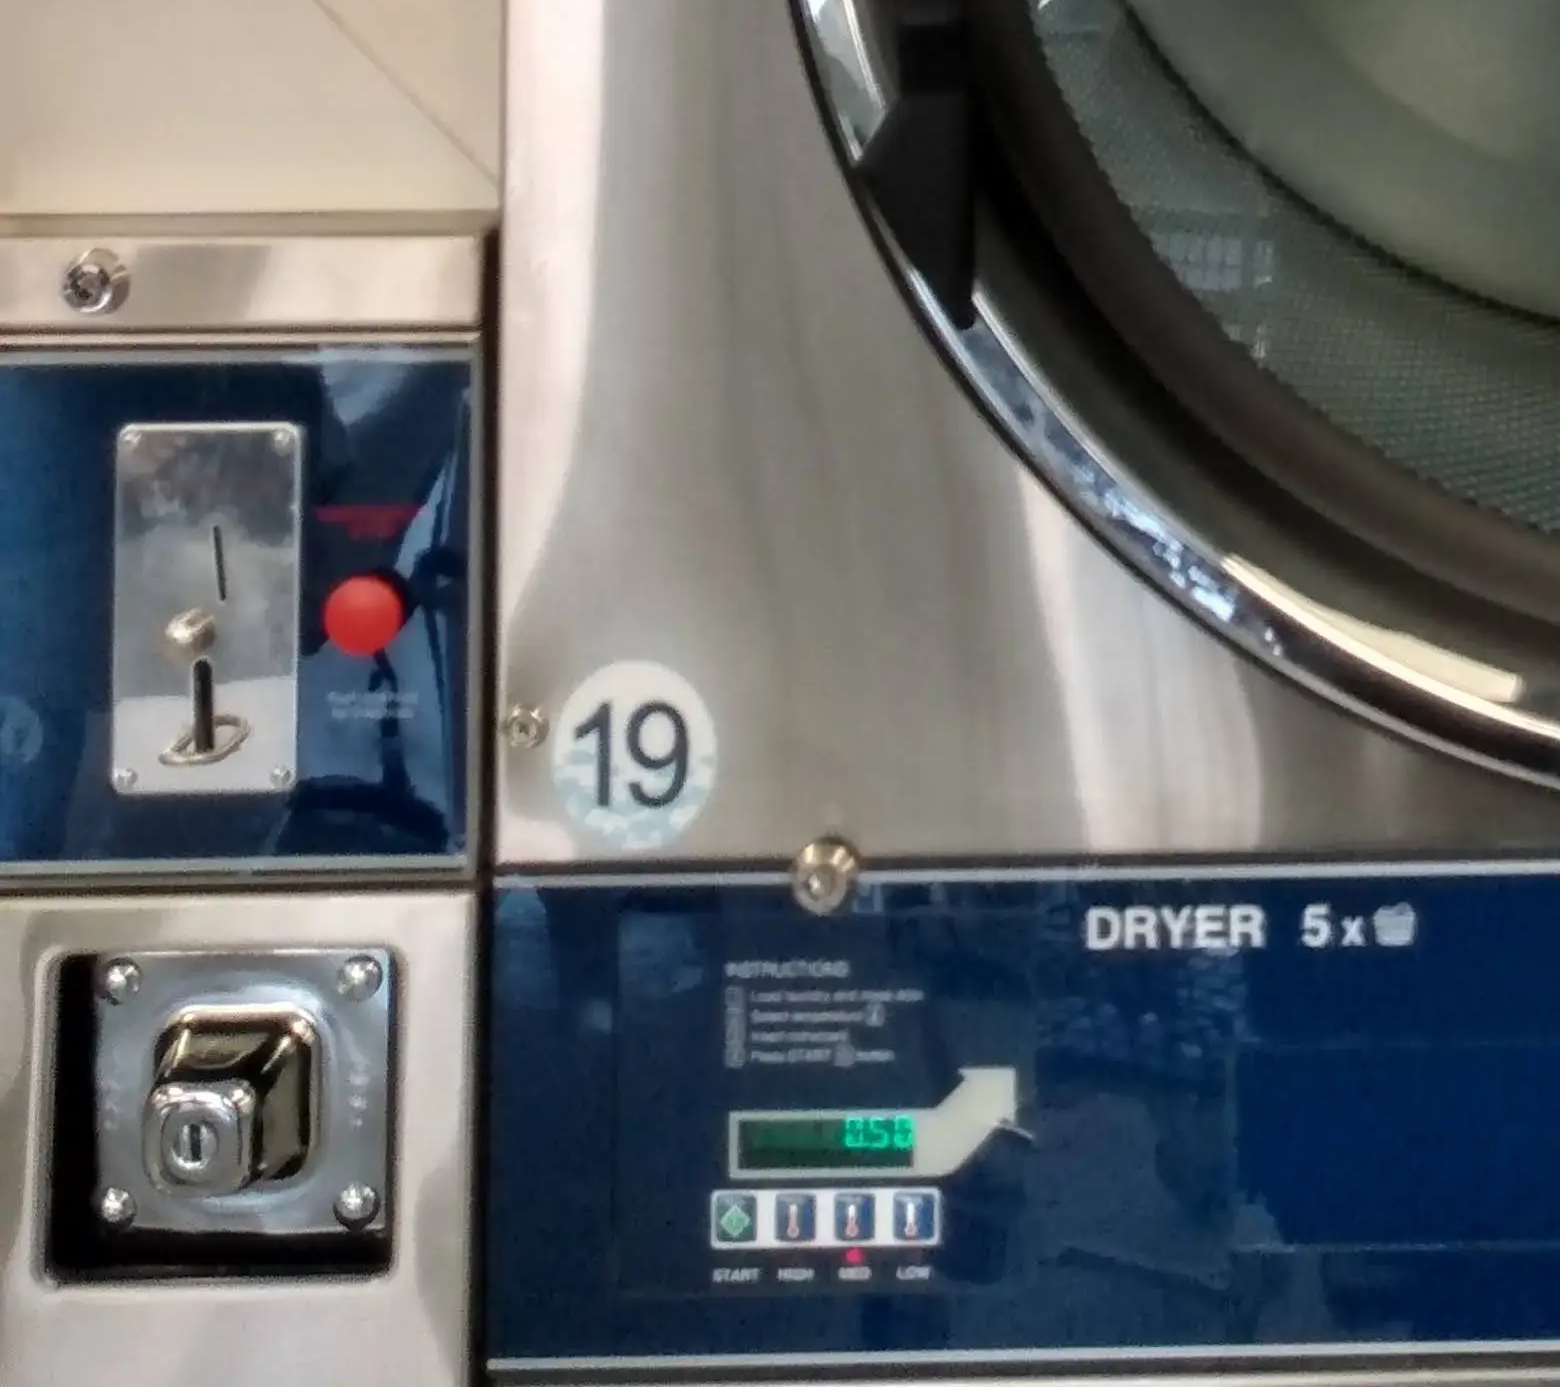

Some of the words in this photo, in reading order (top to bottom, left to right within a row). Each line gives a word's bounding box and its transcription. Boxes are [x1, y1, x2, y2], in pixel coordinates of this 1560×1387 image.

[574, 700, 688, 809] 19
[1085, 904, 1266, 950] DRYER
[1301, 903, 1331, 948] 5
[1342, 915, 1365, 947] x
